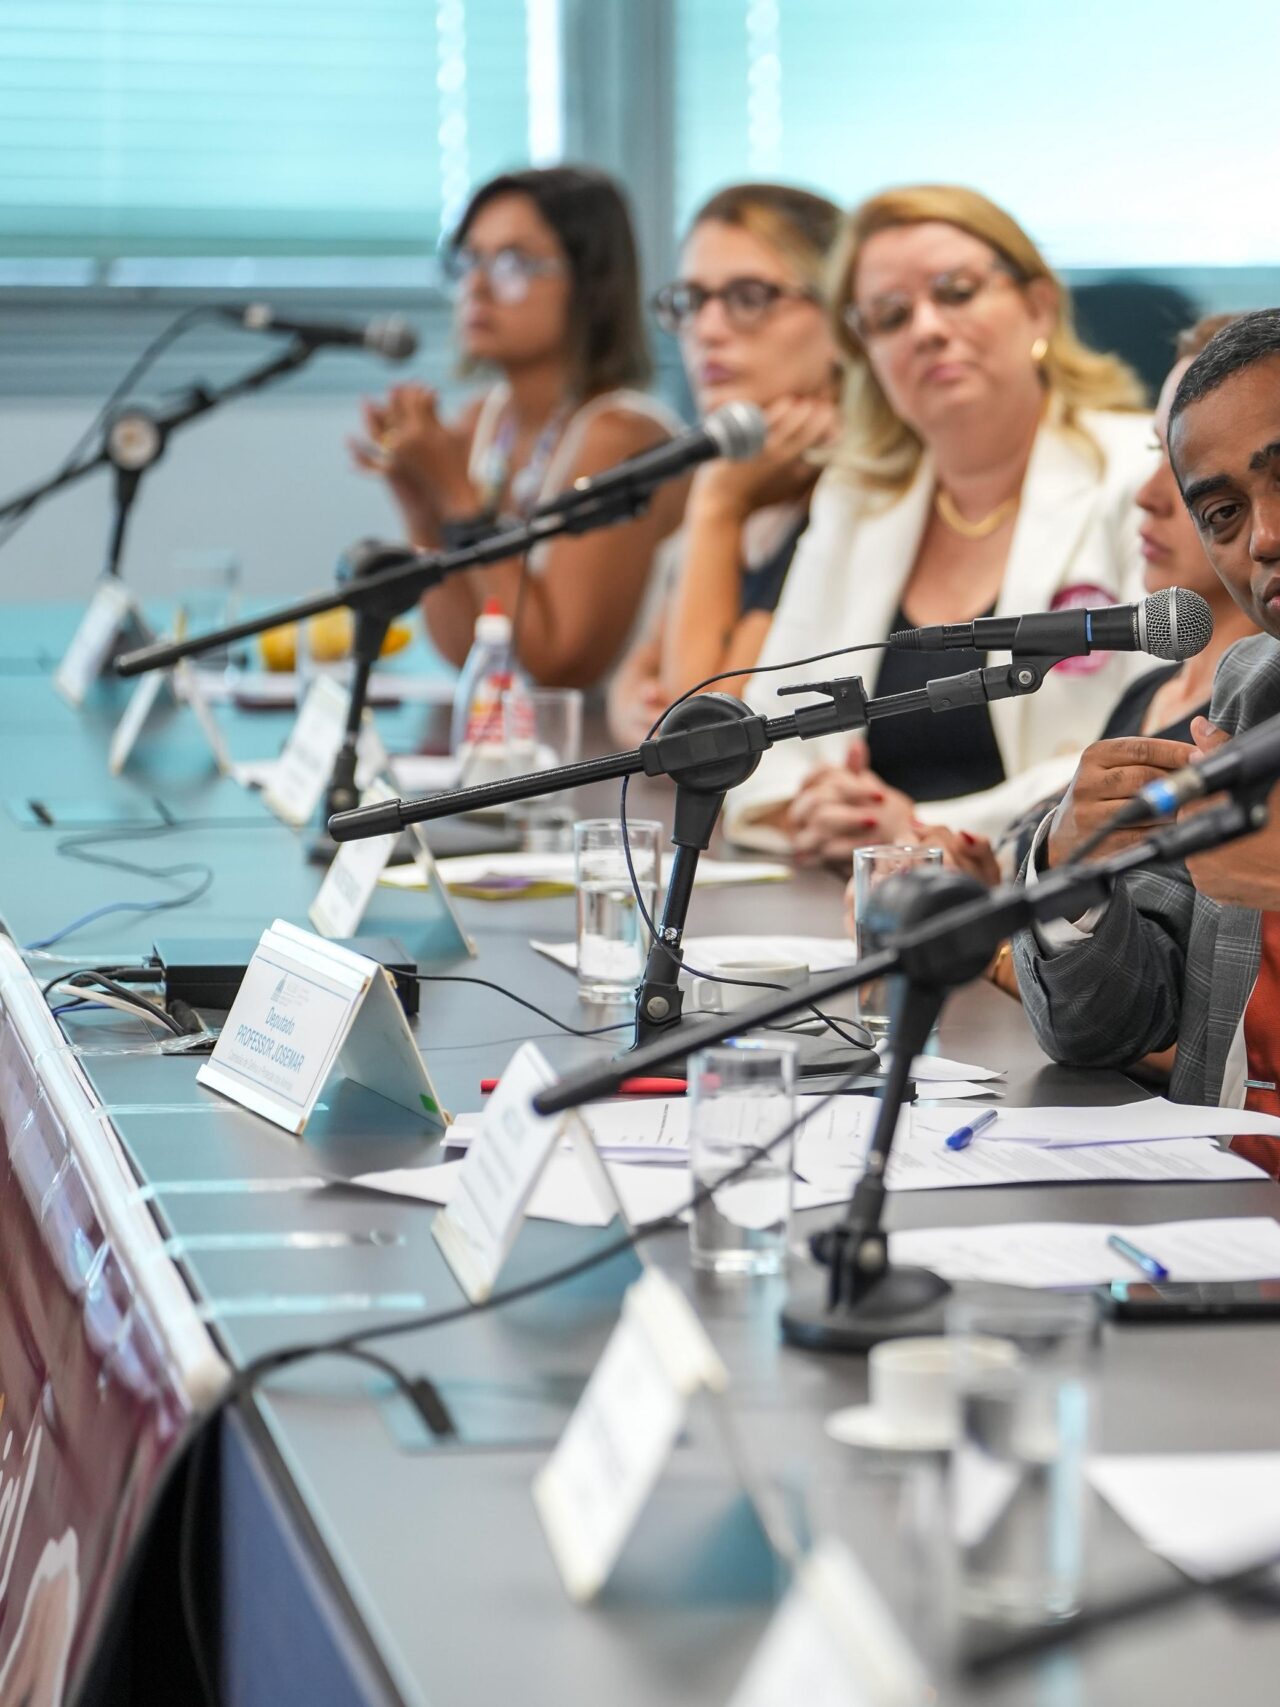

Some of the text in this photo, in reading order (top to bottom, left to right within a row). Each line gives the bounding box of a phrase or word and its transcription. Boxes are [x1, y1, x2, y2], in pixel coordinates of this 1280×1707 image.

[265, 1006, 295, 1035] Deputado
[235, 1024, 275, 1058] PROFESSOR
[271, 1043, 305, 1073] JOSEMAR
